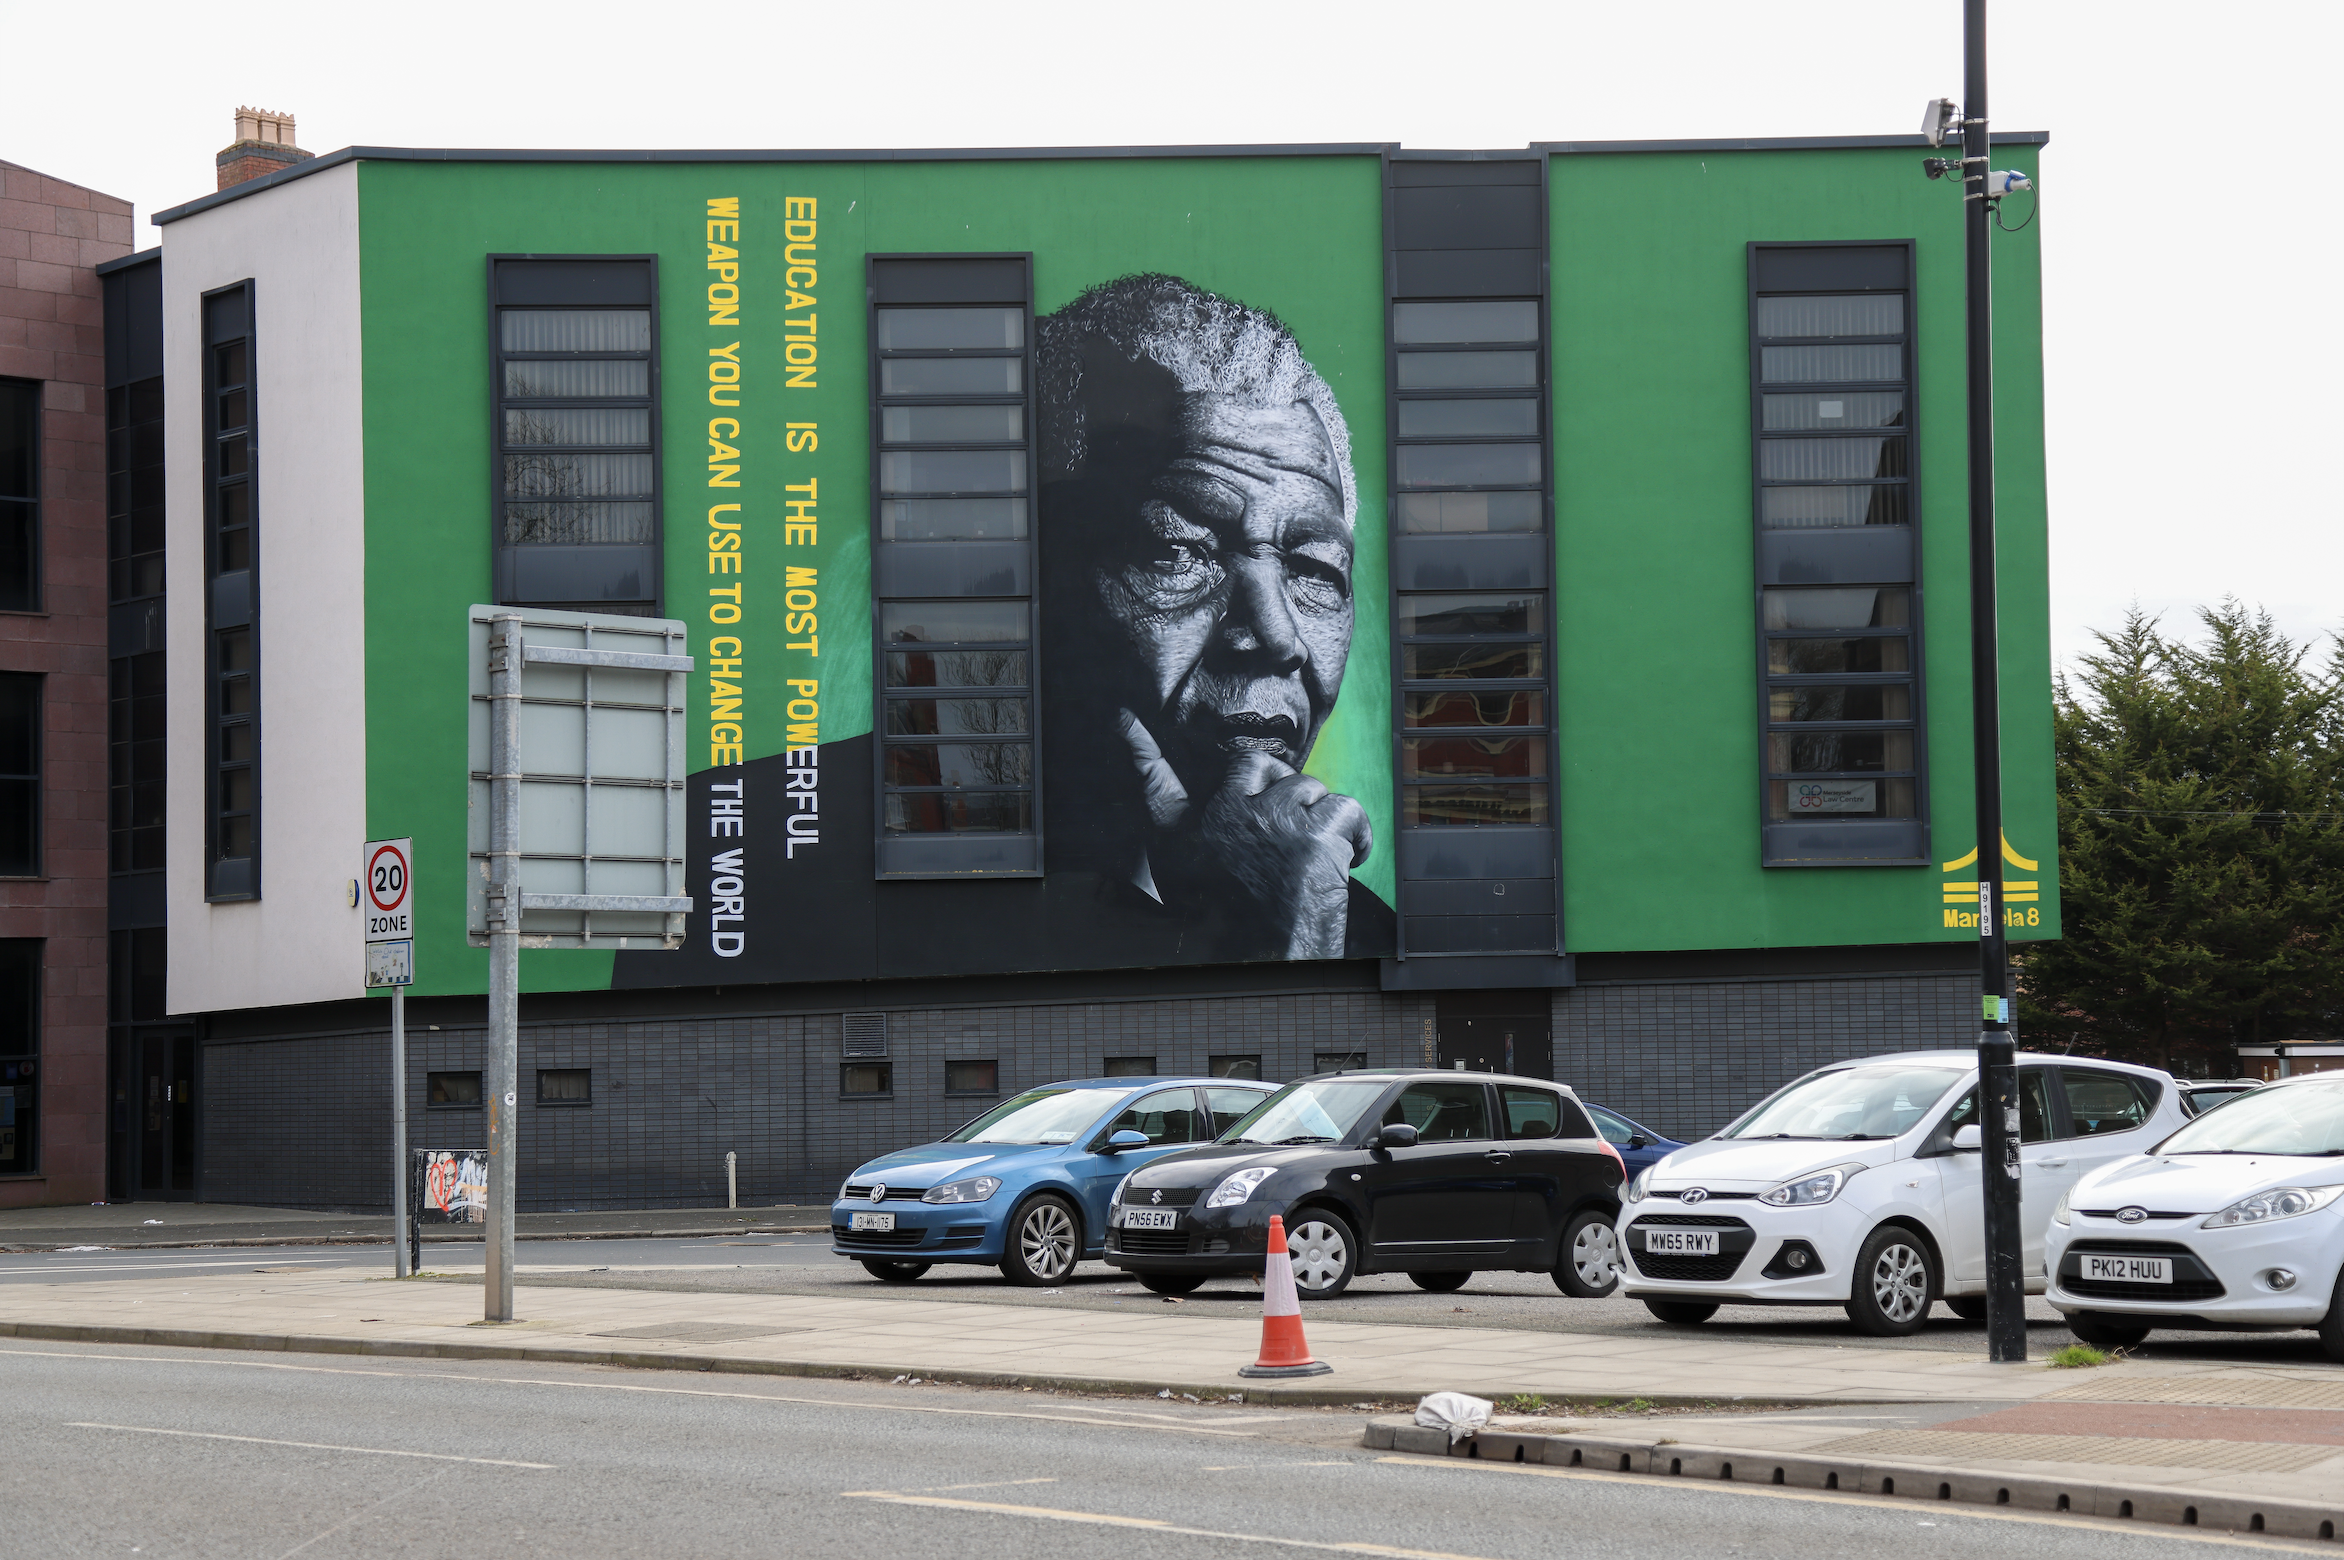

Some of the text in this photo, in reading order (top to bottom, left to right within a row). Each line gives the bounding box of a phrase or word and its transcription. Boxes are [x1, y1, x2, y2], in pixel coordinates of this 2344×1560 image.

[784, 196, 820, 859] EDUCATION IS THE MOST POWERFUL
[706, 196, 745, 958] WEAPON YOU CAN USE TO CHANGE THE WORLD
[374, 865, 403, 893] 20
[1981, 883, 1990, 935] H9195
[371, 915, 408, 934] ZONE
[1424, 1018, 1433, 1063] SERVICES
[1128, 1212, 1173, 1227] PN56 EWX
[2121, 1210, 2140, 1221] Ford
[1651, 1233, 1713, 1251] MW65 RWY
[2091, 1258, 2162, 1279] PK12 HUU
